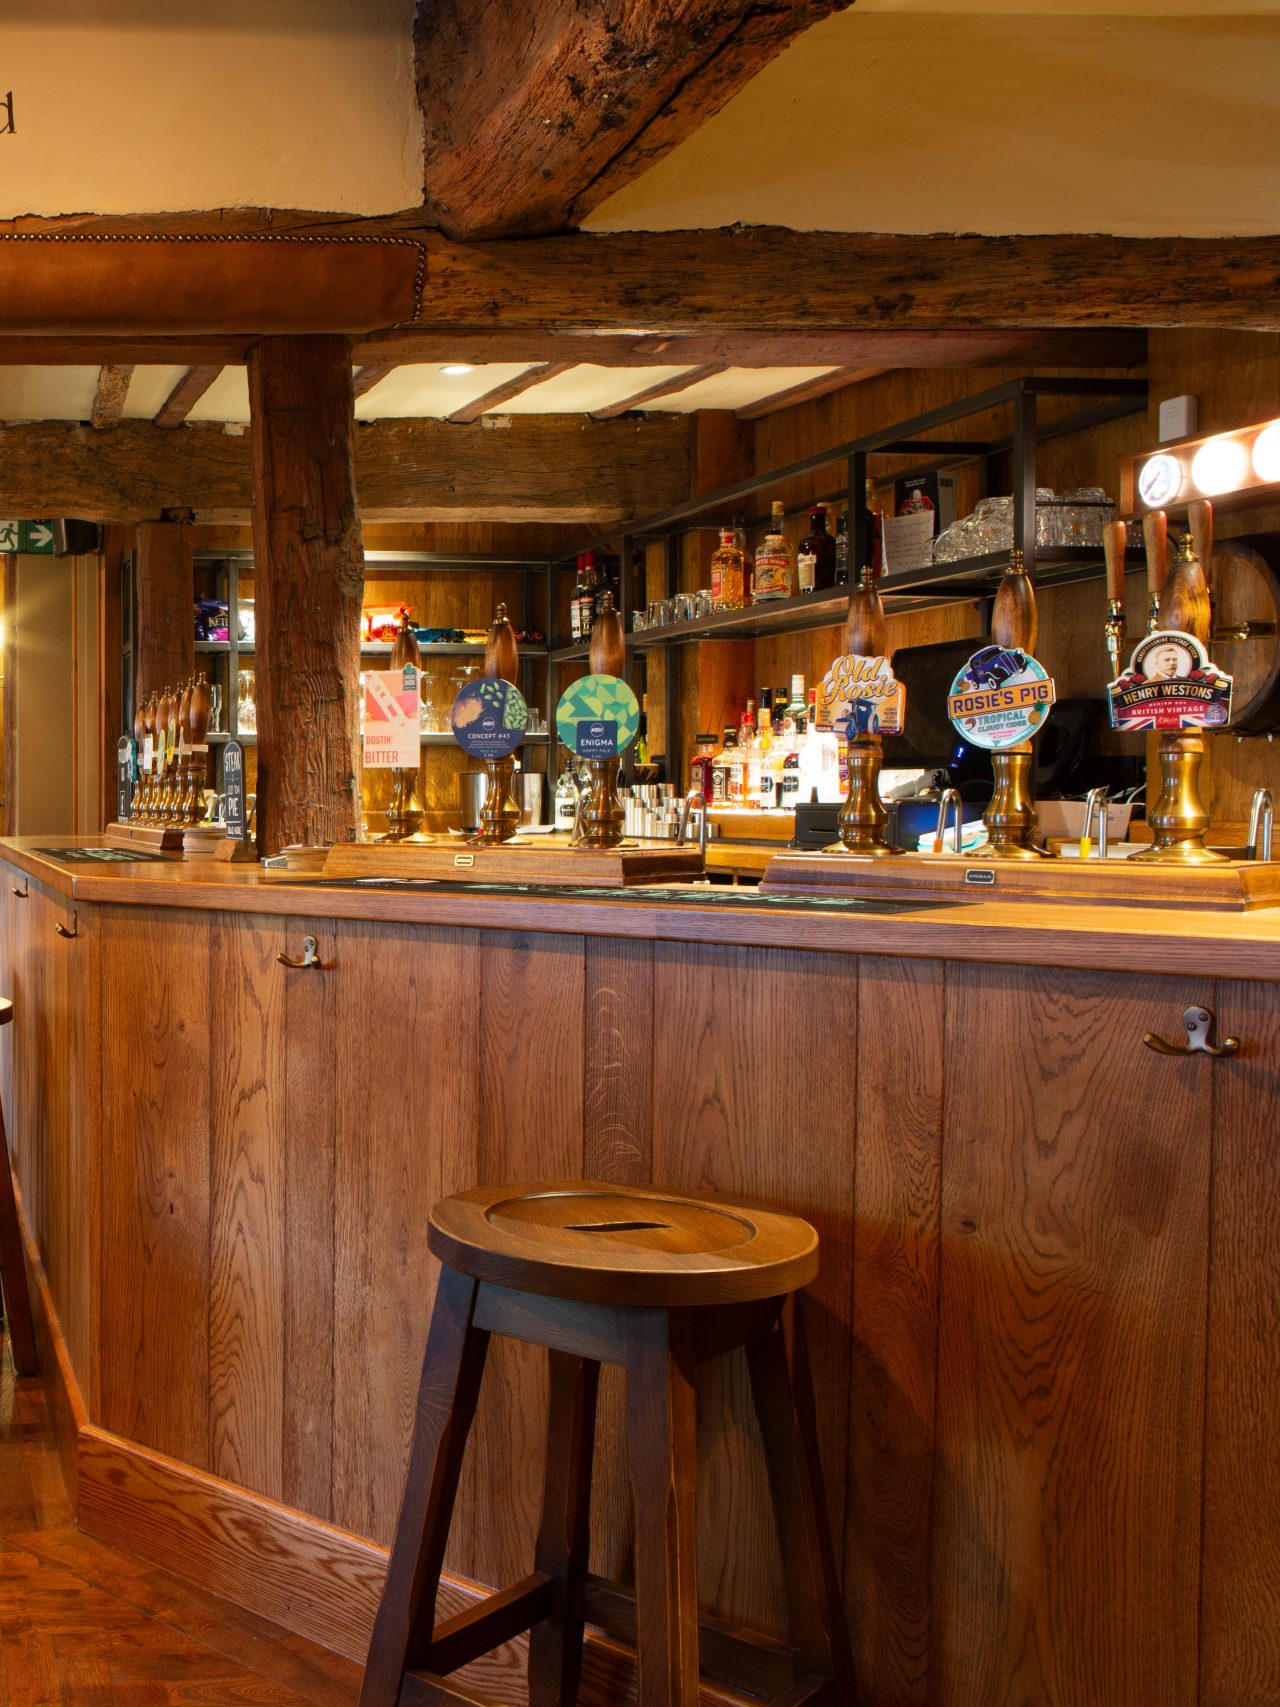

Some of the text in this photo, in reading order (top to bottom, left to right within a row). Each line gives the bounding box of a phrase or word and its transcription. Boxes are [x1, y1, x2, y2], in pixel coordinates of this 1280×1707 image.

[832, 655, 884, 682] Old
[820, 675, 897, 705] Rosie
[1123, 685, 1214, 704] HENRY WESTONS
[977, 710, 1026, 725] TROPICAL
[1131, 707, 1164, 715] BRITISH
[977, 720, 1027, 732] CLOUDY CIDER
[365, 751, 399, 764] BITTER
[228, 797, 239, 817] PIE
